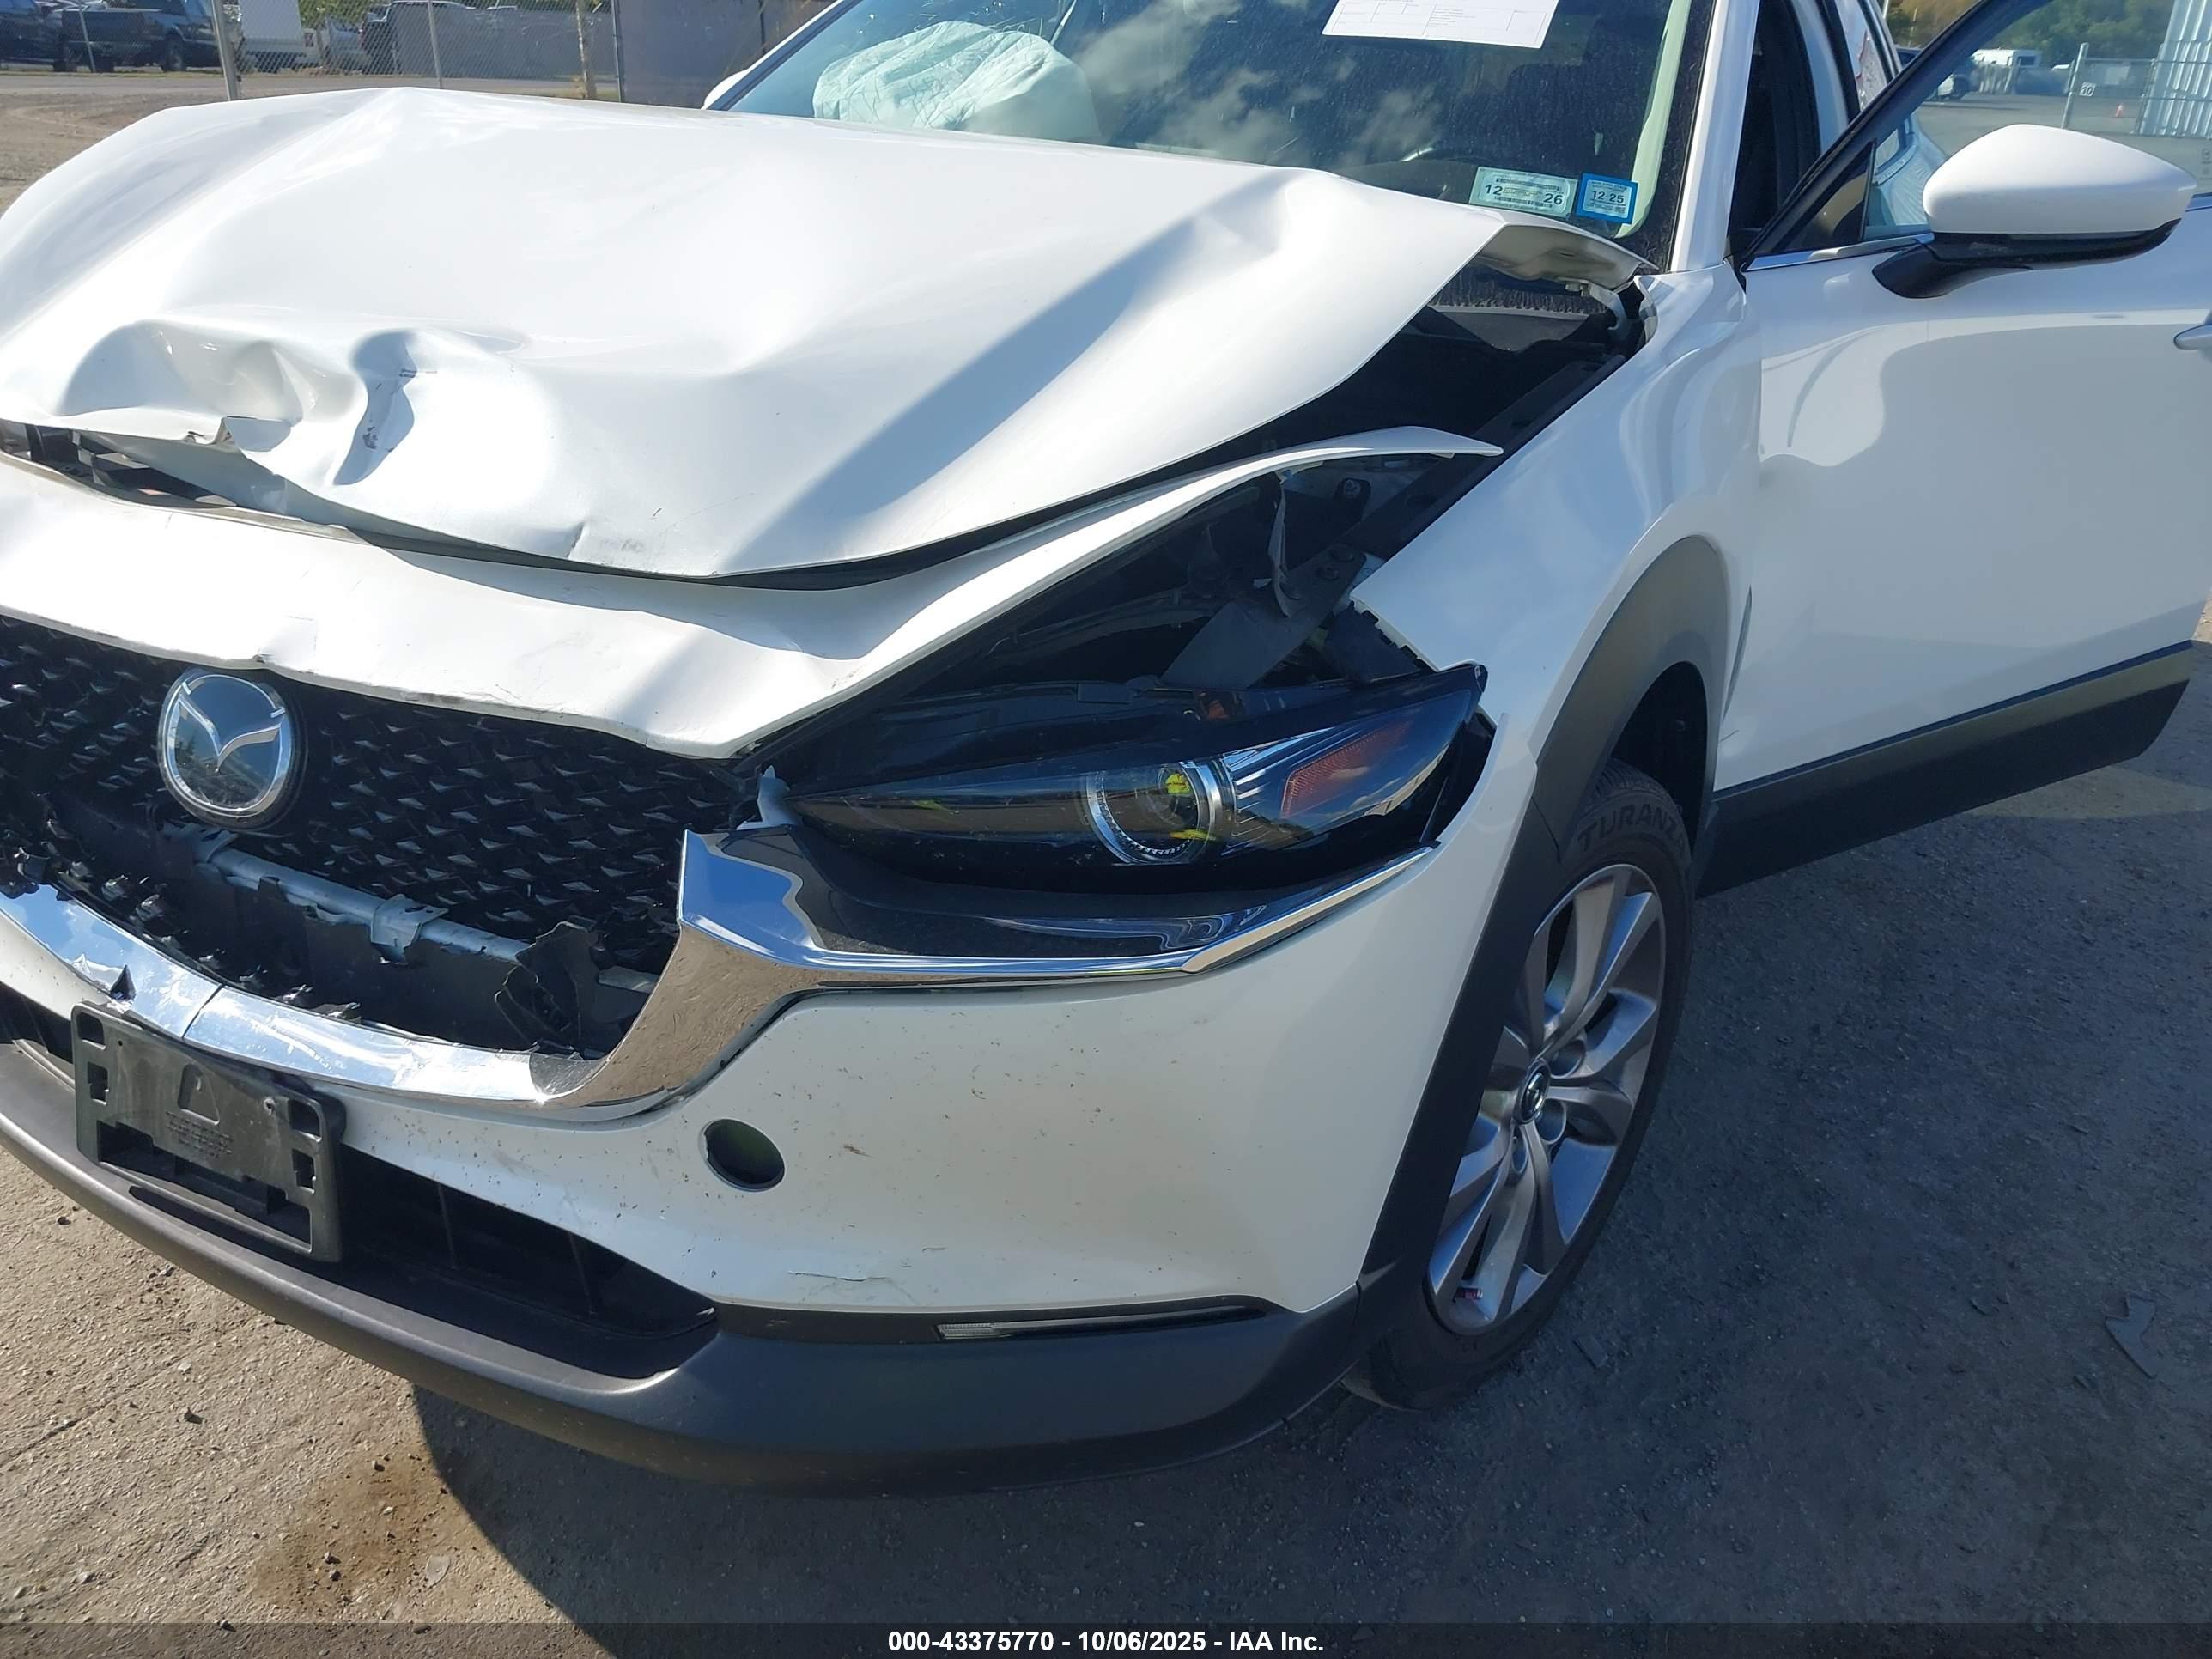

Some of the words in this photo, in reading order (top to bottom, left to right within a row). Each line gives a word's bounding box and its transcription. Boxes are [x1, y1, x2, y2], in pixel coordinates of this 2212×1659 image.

[1484, 184, 1504, 196] 12
[1543, 192, 1564, 205] 26
[1592, 191, 1606, 200] 12
[1609, 192, 1625, 204] 25
